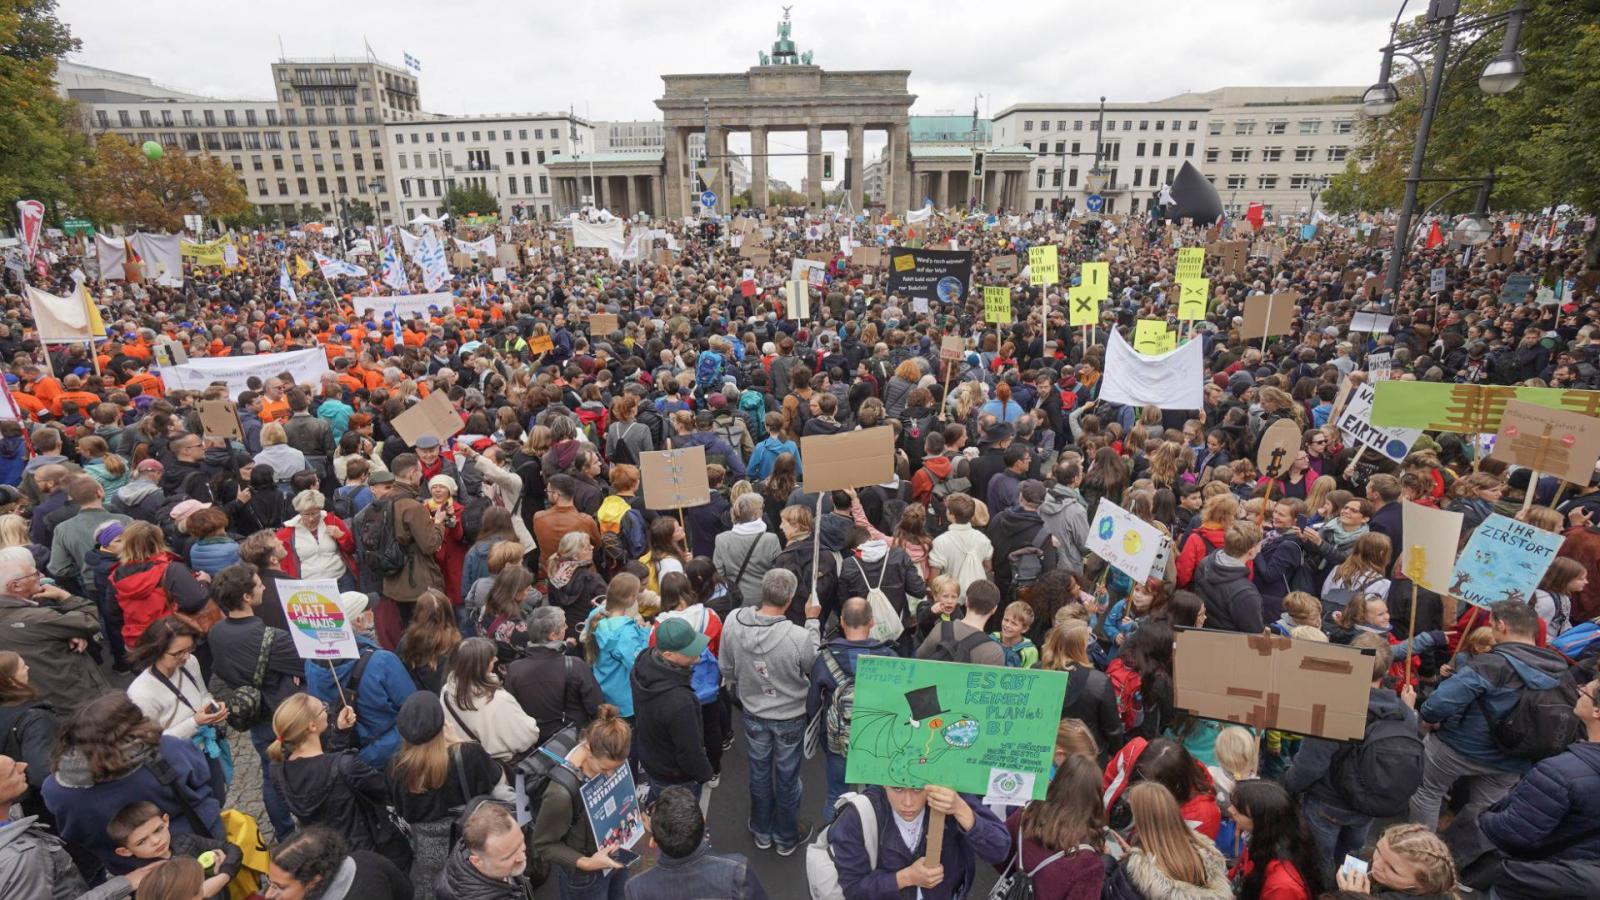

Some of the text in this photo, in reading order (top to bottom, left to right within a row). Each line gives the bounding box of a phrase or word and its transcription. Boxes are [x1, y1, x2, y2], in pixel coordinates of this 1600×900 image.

[1031, 264, 1055, 273] KOMMT
[985, 287, 1004, 296] THERE
[986, 304, 1009, 313] PLANET
[994, 297, 1003, 305] NO
[1342, 414, 1388, 449] EARTH
[1507, 523, 1535, 538] IHR
[1463, 590, 1492, 607] UNS
[292, 603, 328, 618] PLATZ
[309, 617, 336, 628] NAZIS
[967, 671, 997, 689] ES
[964, 688, 1030, 706] KEINEN
